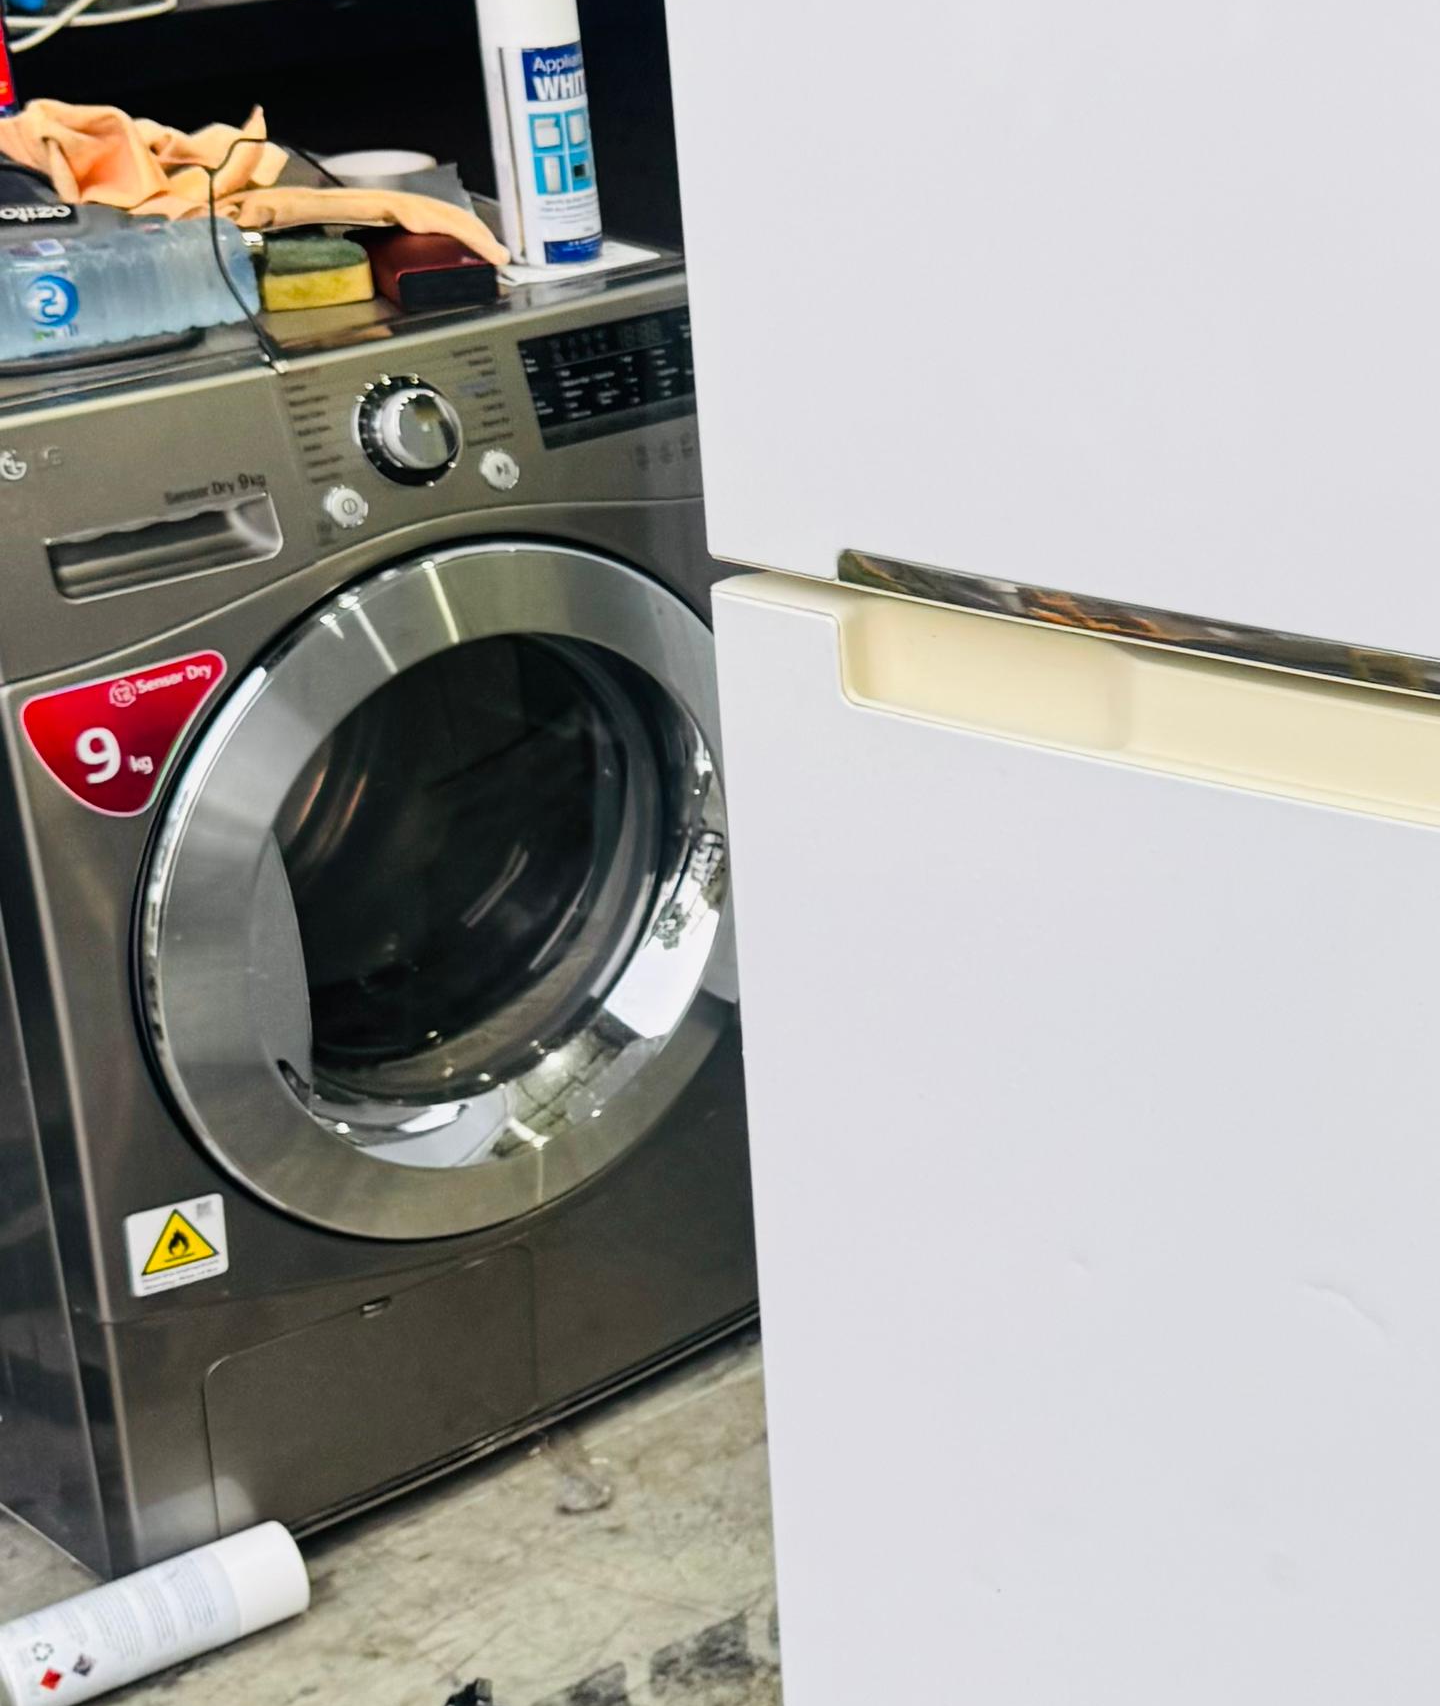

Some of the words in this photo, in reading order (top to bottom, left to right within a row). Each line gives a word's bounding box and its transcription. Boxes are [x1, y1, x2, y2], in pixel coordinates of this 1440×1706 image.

[211, 480, 235, 496] Dry
[135, 671, 185, 696] Sensor
[185, 663, 213, 680] Dry
[75, 727, 121, 784] 9
[128, 754, 154, 775] kg
